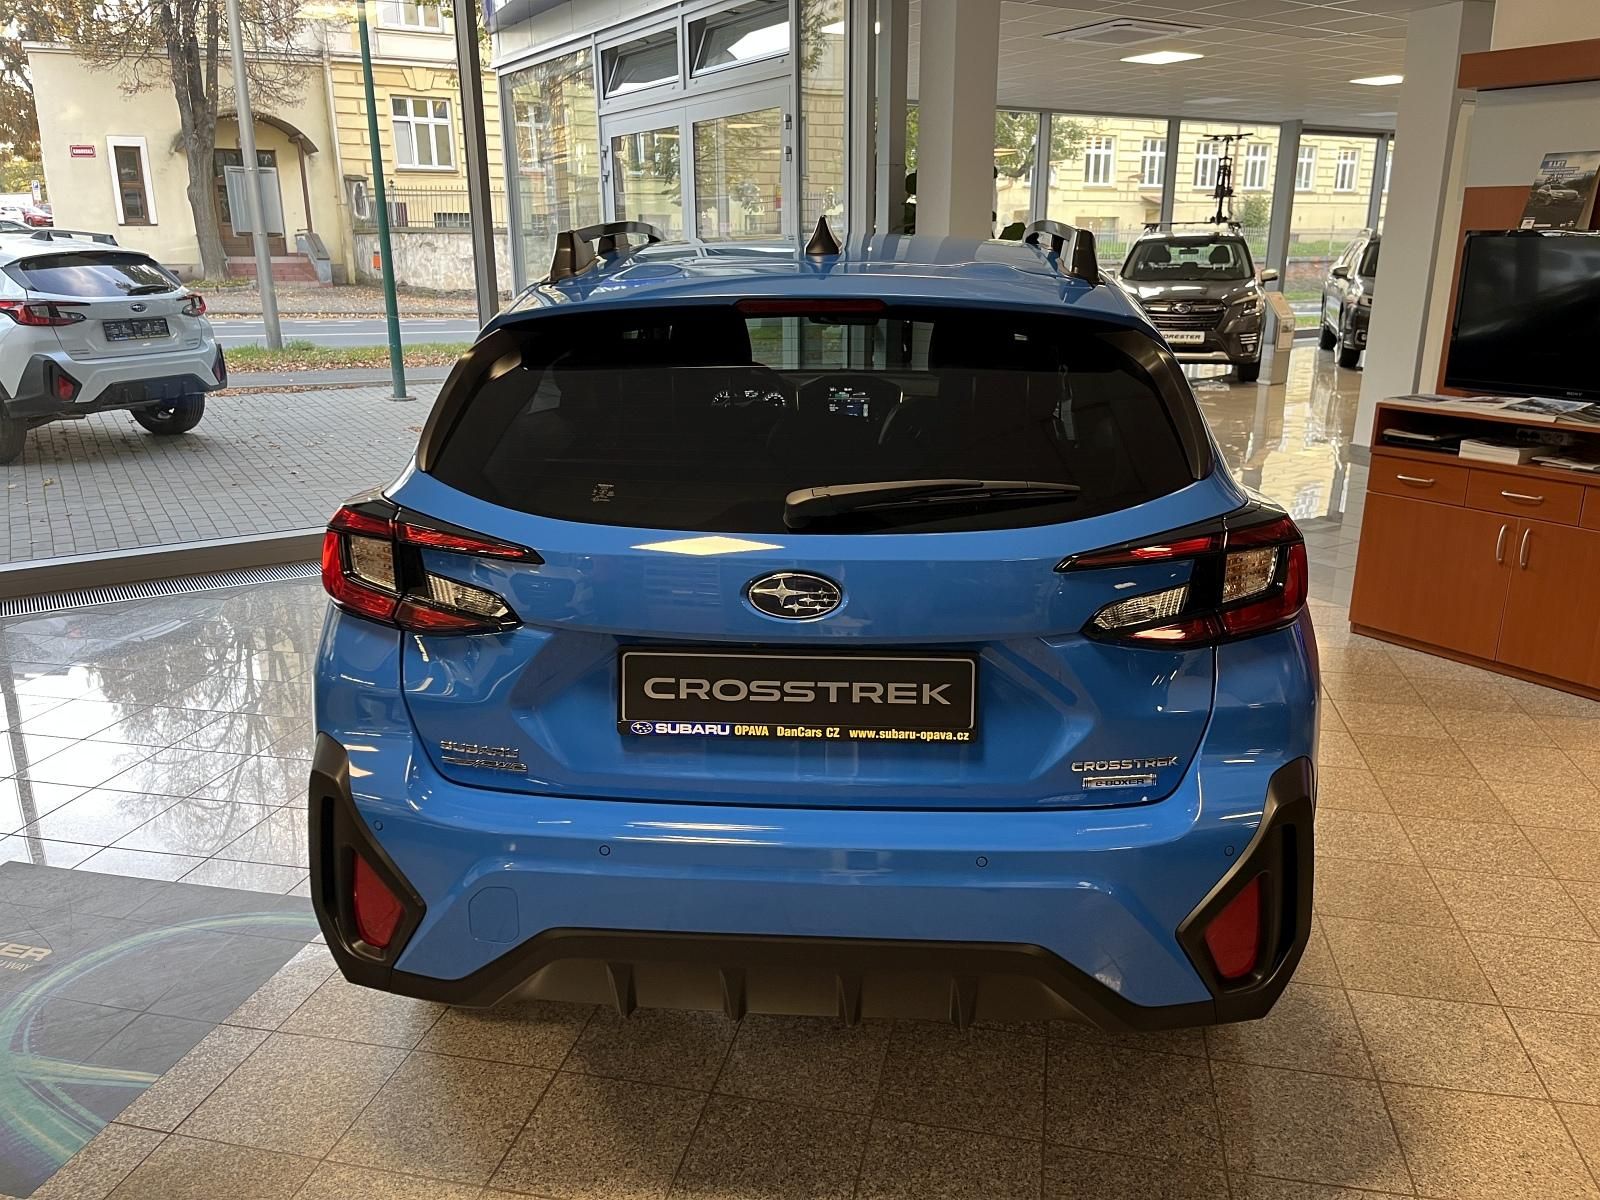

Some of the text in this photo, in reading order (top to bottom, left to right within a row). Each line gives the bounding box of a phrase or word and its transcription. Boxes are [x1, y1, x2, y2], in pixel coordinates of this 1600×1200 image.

[643, 677, 952, 705] CROSSTREK
[655, 723, 970, 742] SUBARU OPAVA DanCars CZ www.subaru-opava.cz
[440, 740, 520, 758] SUBARU
[1071, 756, 1179, 772] CROSSTREK
[0, 942, 52, 962] ER
